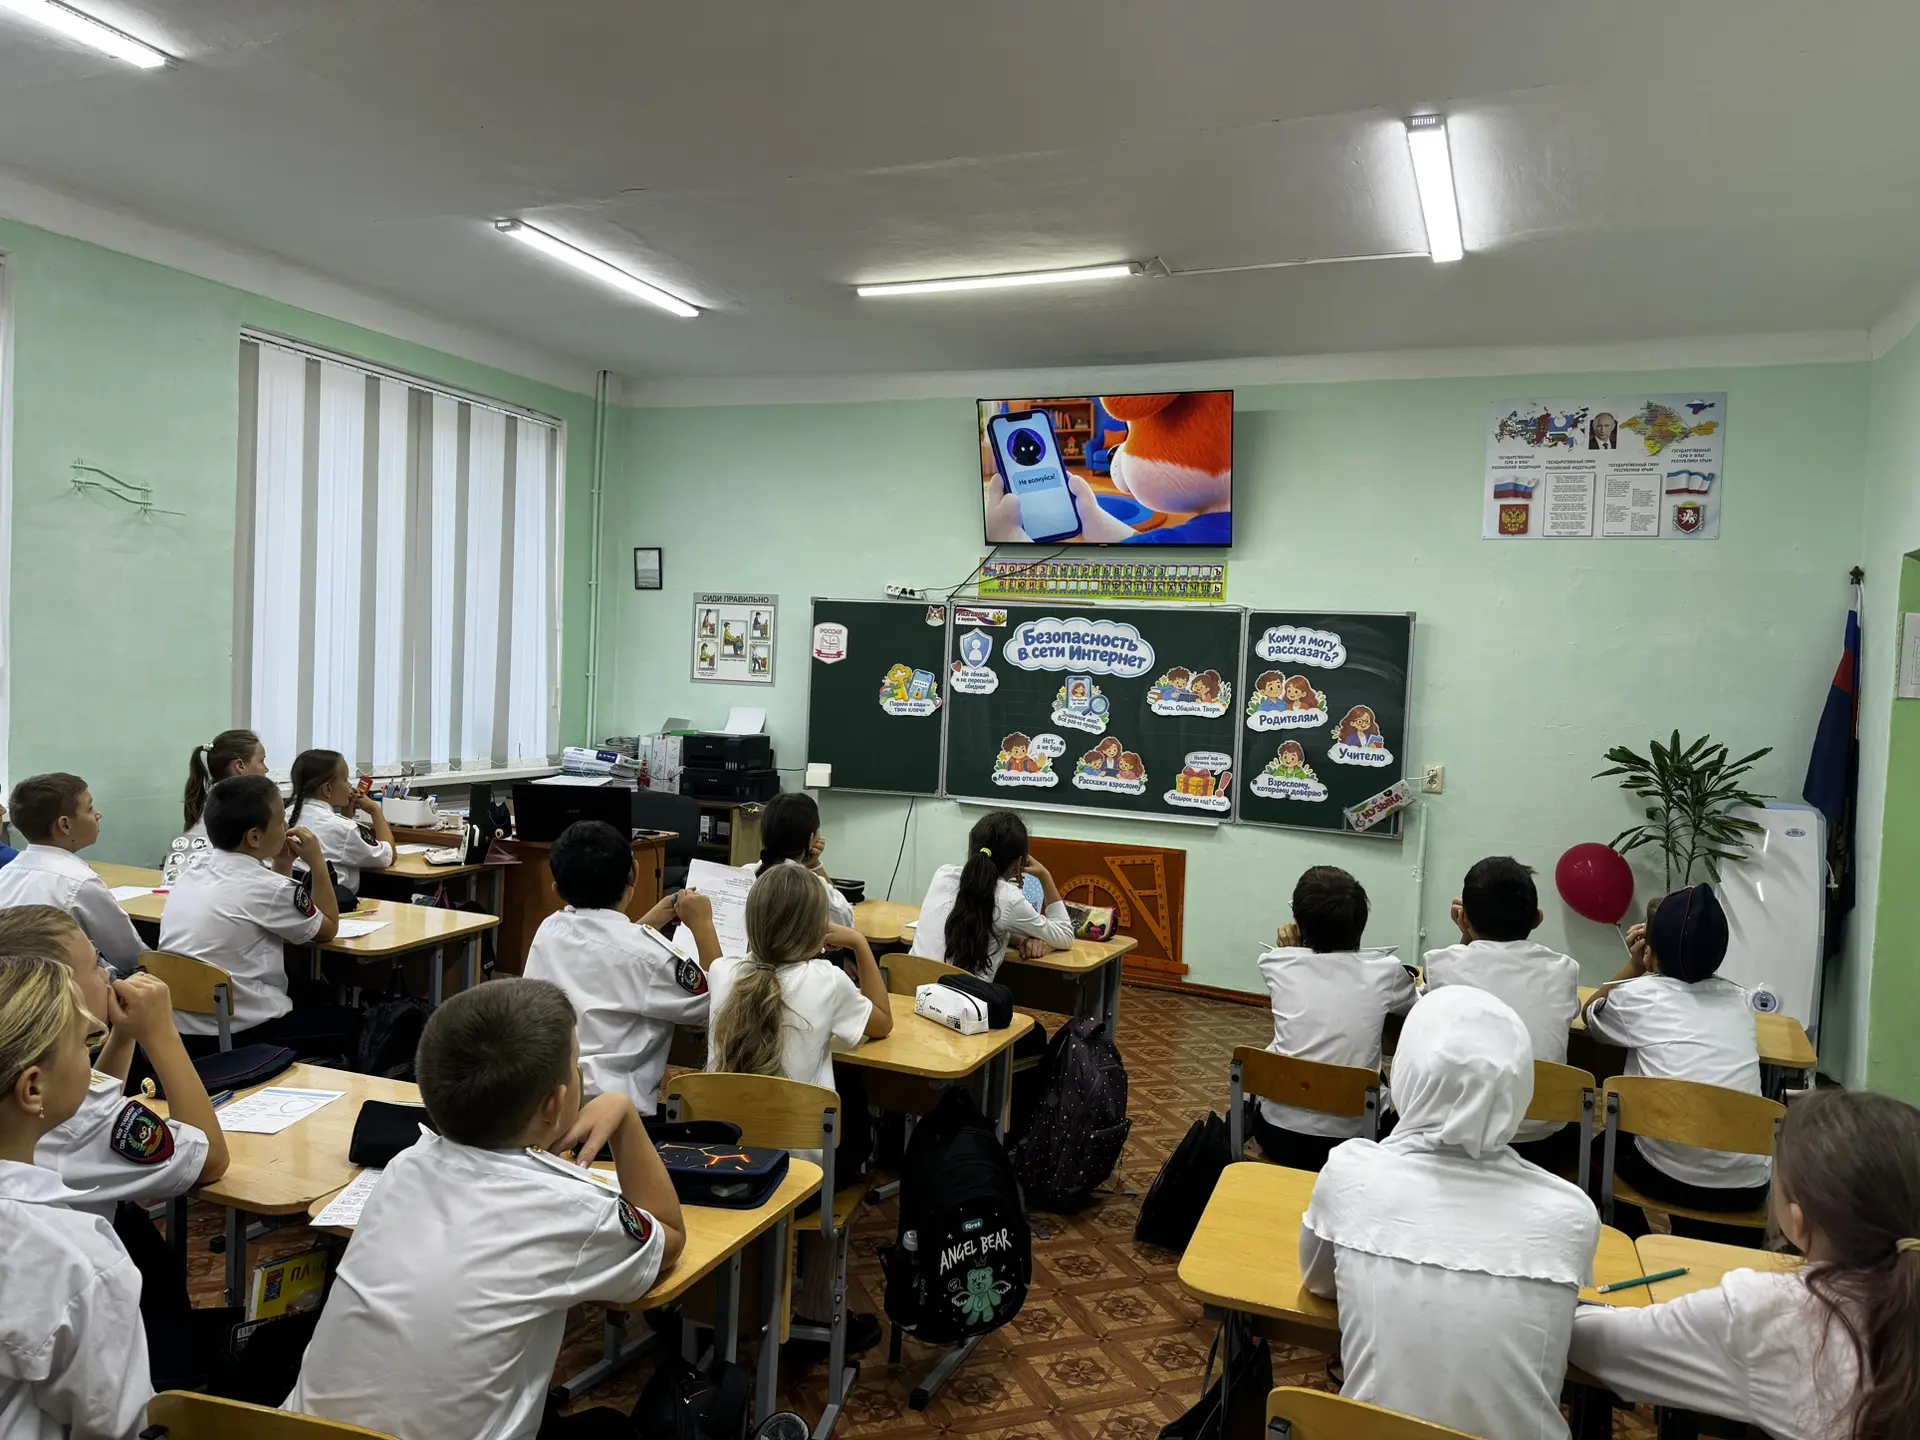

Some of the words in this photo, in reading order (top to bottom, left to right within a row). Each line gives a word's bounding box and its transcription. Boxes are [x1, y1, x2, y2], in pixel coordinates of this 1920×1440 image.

[1023, 628, 1138, 652] Безопасность
[1268, 633, 1296, 645] Кому
[1298, 636, 1306, 644] я
[1308, 637, 1337, 652] могу
[1018, 647, 1029, 660] в
[1032, 646, 1065, 659] сети
[1069, 645, 1146, 669] Интернет
[1268, 646, 1339, 662] рассказать?
[1259, 714, 1319, 726] Родителям
[1049, 744, 1062, 753] буду
[1339, 748, 1385, 761] Учителю
[998, 774, 1020, 782] Можно
[1078, 776, 1108, 787] Расскажи
[1108, 781, 1141, 791] взрослому
[1268, 778, 1310, 791] Взрослому,
[1170, 794, 1192, 802] Подарок
[1257, 786, 1289, 794] которому
[1290, 789, 1321, 797] доверяю
[1361, 793, 1403, 819] МУЗЫКА
[939, 1239, 978, 1276] ANGEL
[980, 1228, 1012, 1255] BEAR
